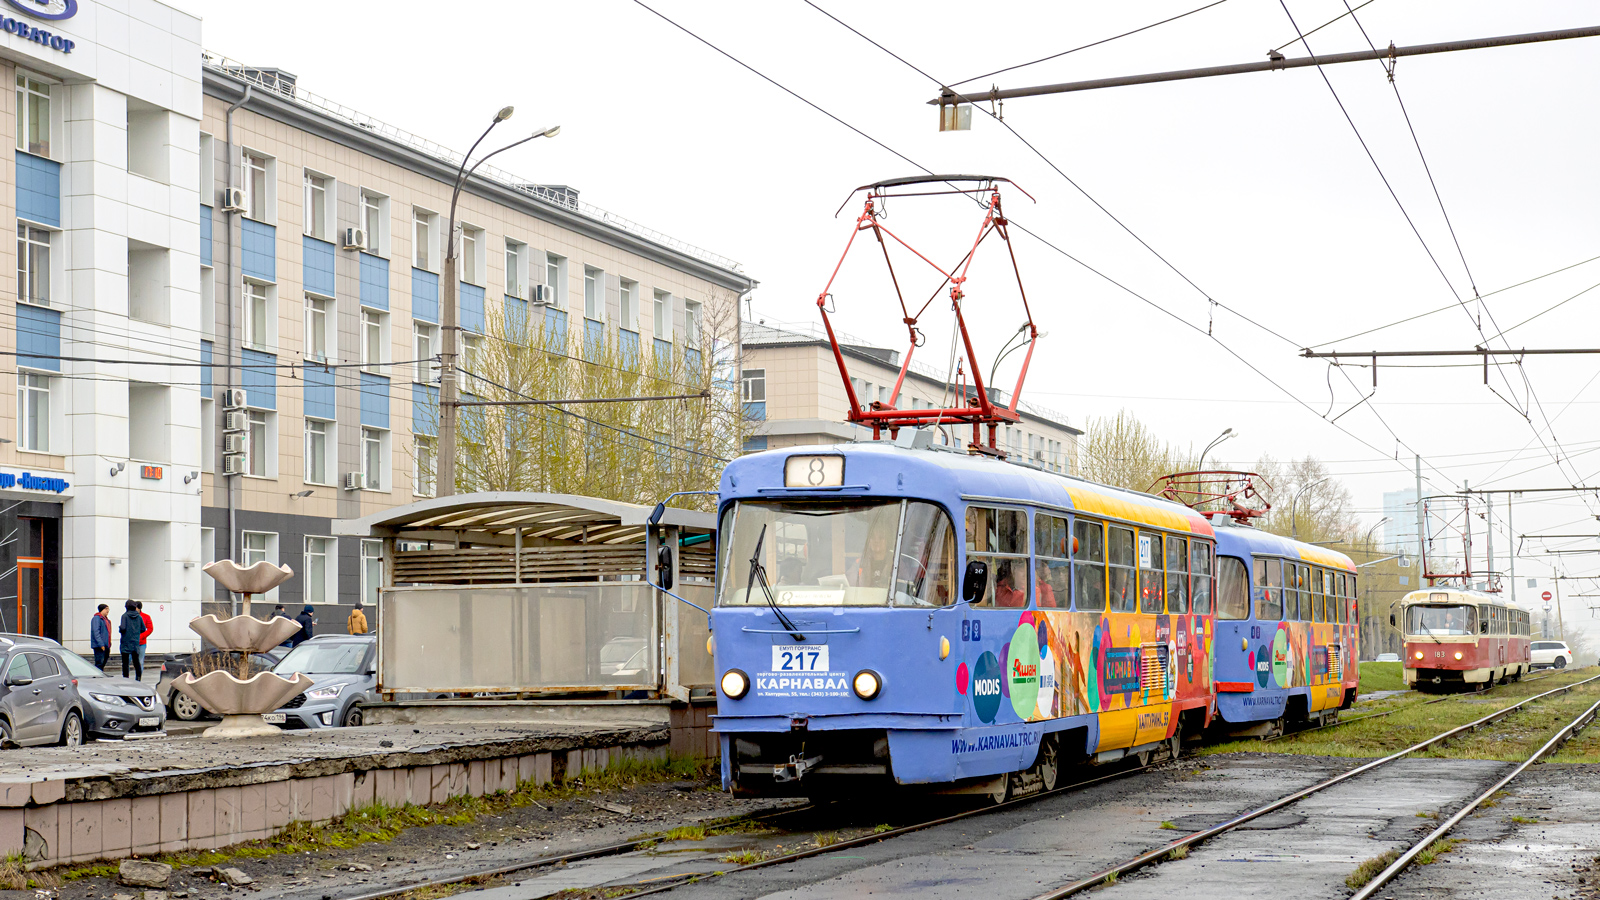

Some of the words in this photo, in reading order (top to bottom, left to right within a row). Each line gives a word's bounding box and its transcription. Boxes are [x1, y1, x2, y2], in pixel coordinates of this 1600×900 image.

[0, 14, 76, 54] ОВАТОР
[808, 458, 825, 486] 8
[781, 652, 820, 670] 217
[1257, 661, 1270, 671] MODIS
[756, 678, 849, 690] КАРНАВАЛ
[974, 679, 1000, 696] MODIS
